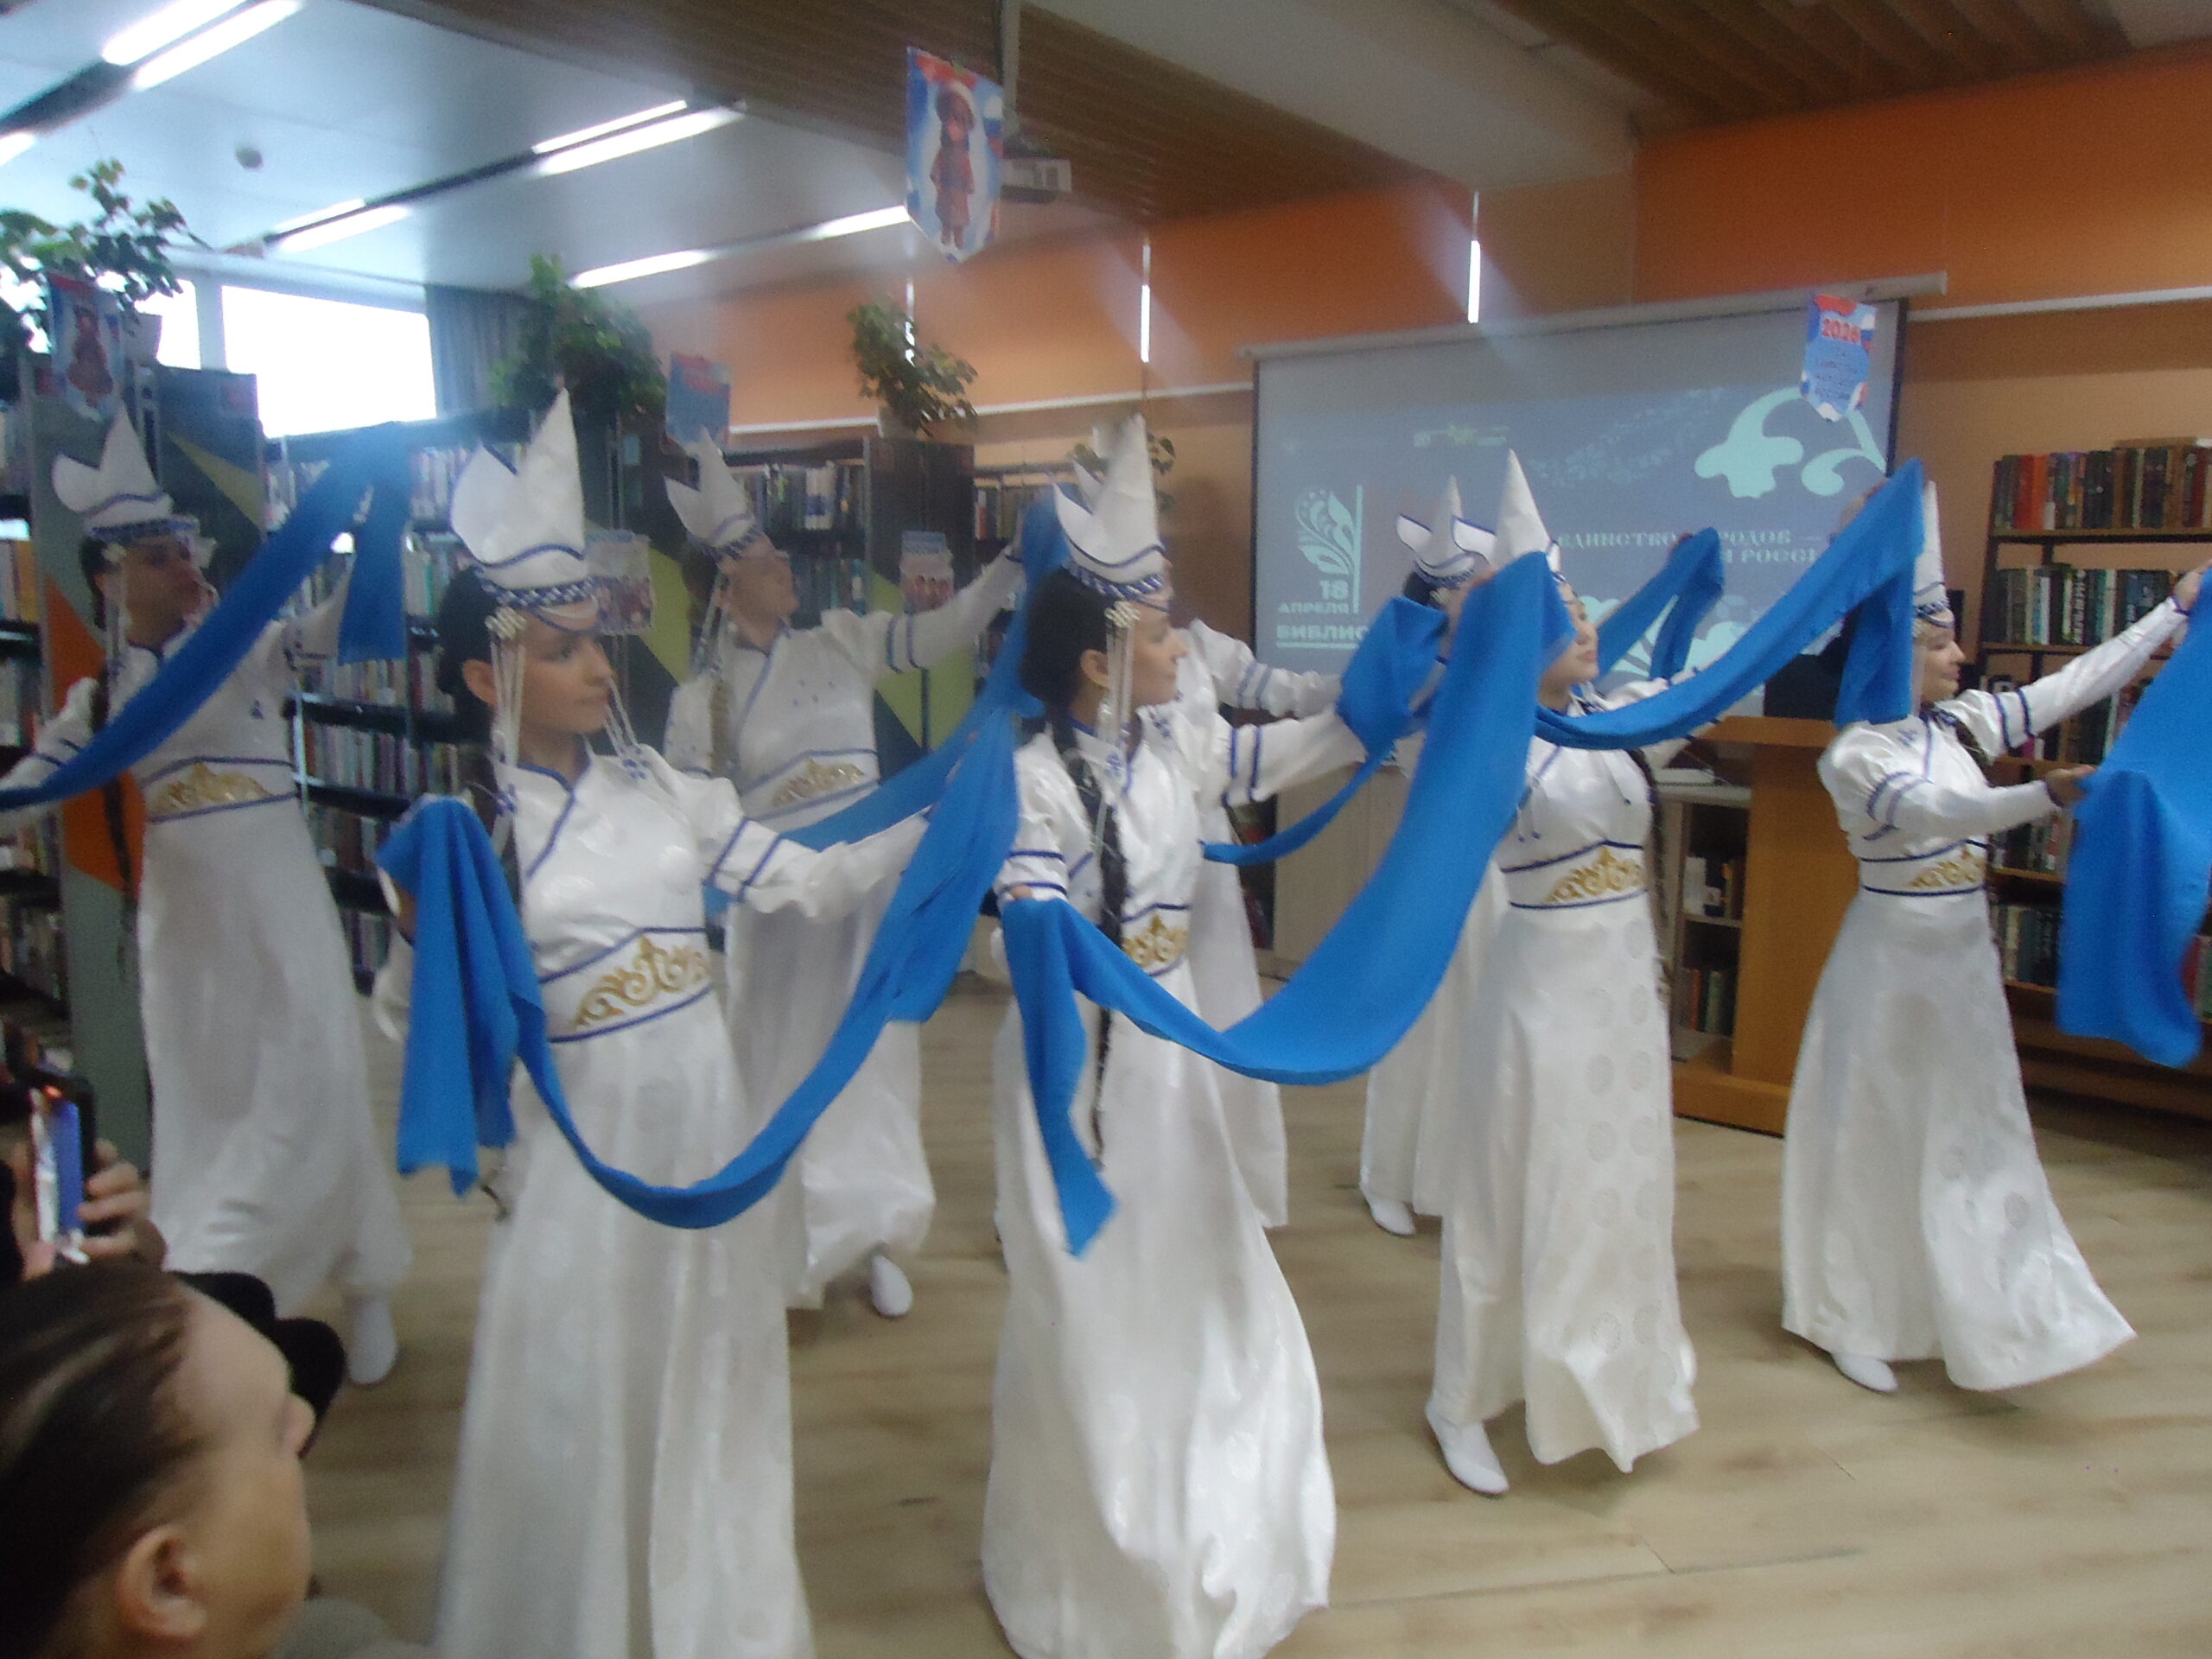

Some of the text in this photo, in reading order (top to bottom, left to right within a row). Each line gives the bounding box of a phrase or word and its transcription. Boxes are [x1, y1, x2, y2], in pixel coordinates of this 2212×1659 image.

[1717, 529, 1791, 547] РОДОВ
[1741, 548, 1815, 563] РОСС
[1319, 580, 1349, 600] 18
[1279, 601, 1350, 614] АПРЕЛЯ
[1276, 625, 1370, 640] БИБЛИО
